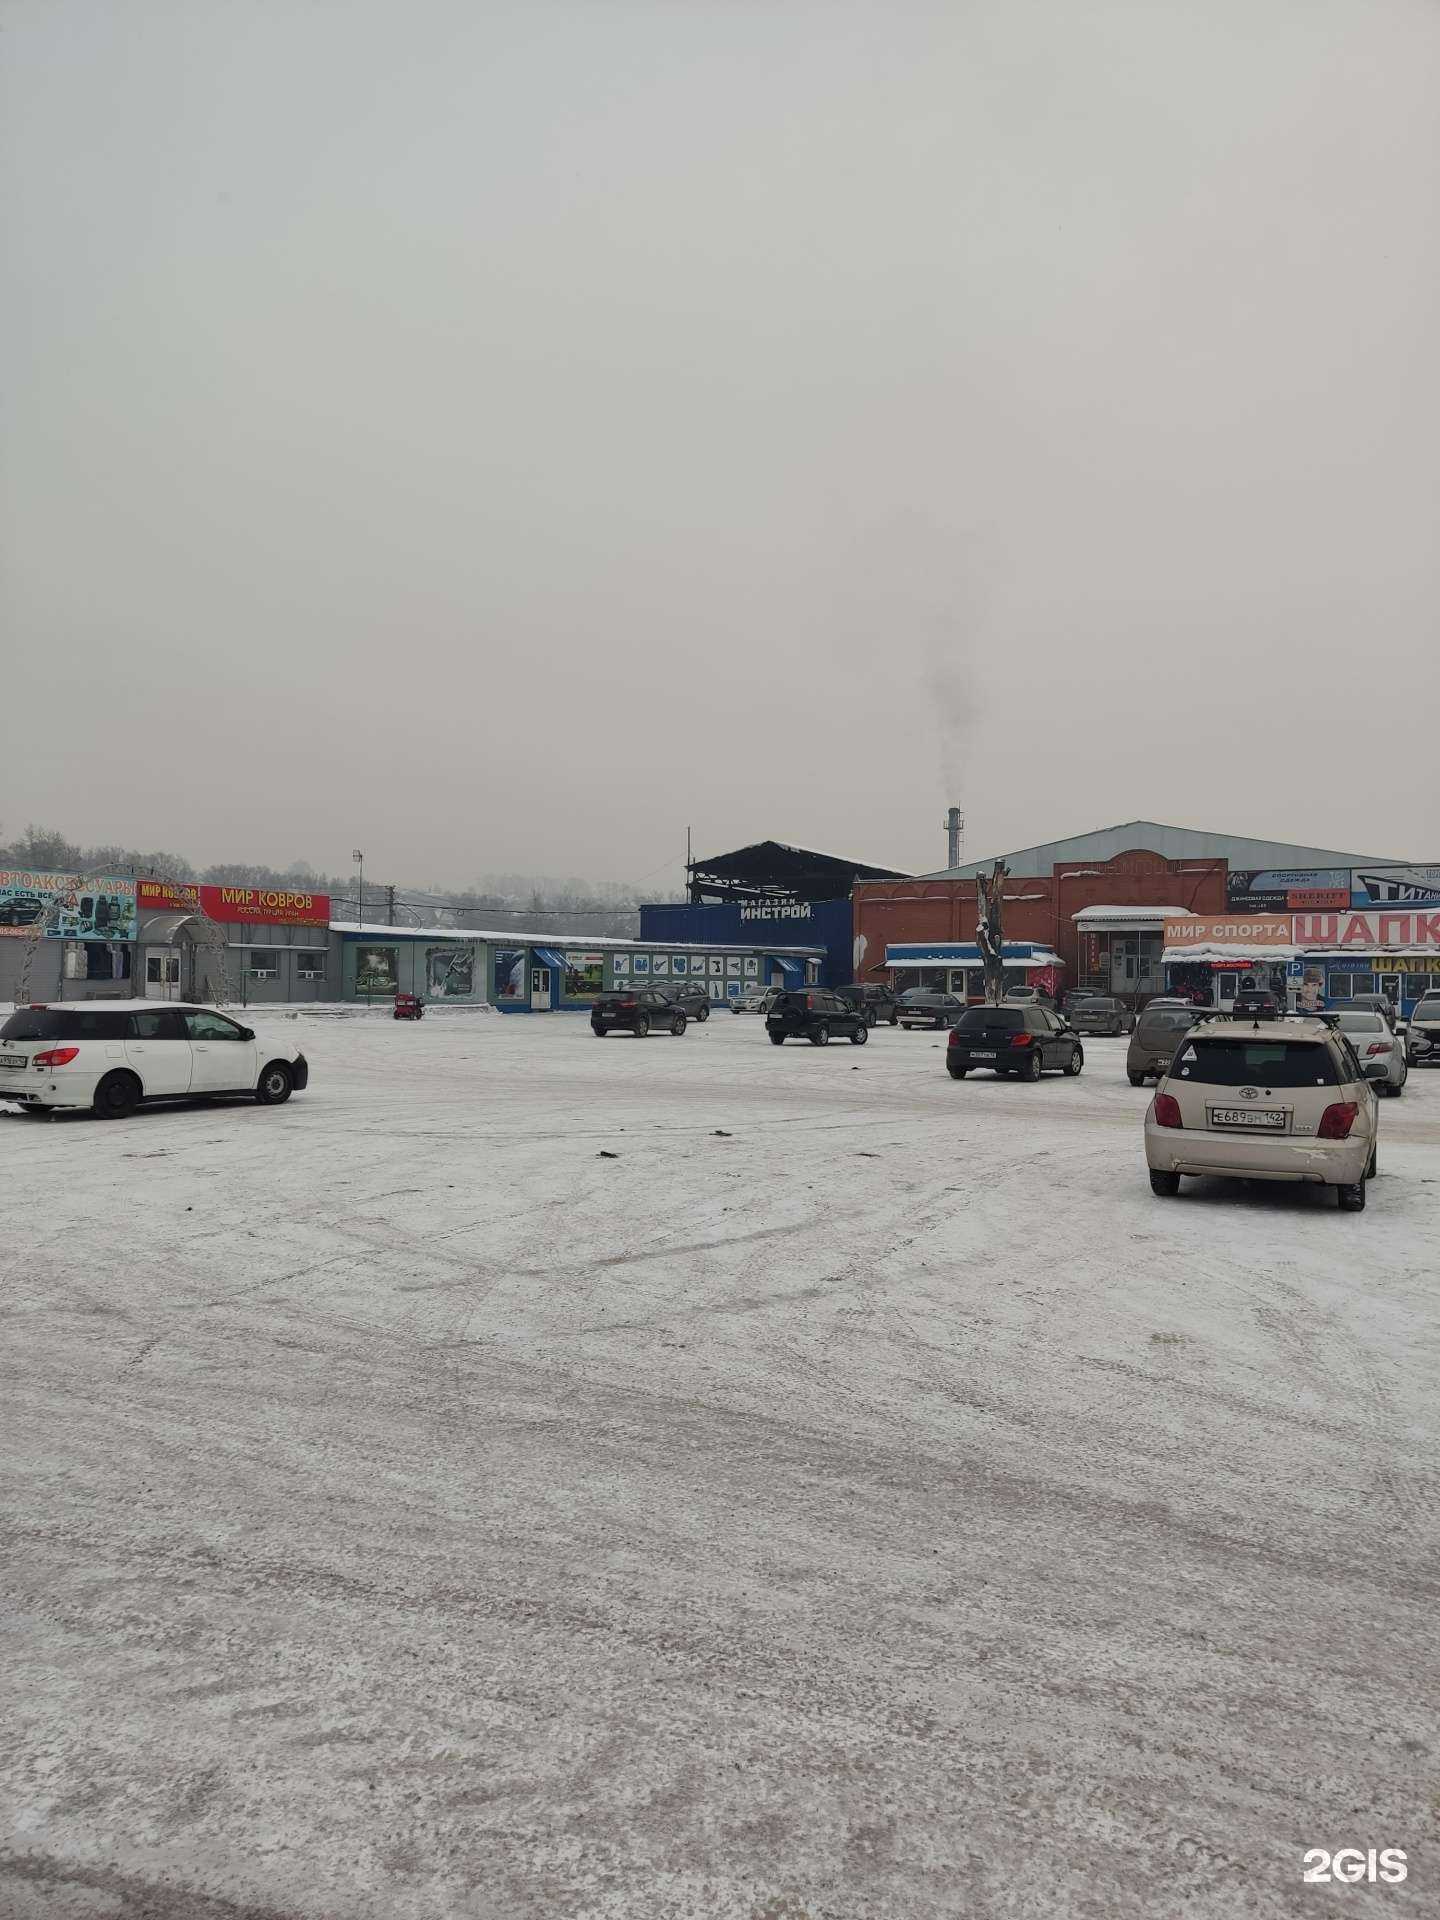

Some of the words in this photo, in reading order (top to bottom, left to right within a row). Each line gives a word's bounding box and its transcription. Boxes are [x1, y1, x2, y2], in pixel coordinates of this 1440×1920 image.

[15, 890, 36, 898] ЕСТЬ
[141, 883, 160, 897] МИР
[221, 888, 253, 904] МИР
[258, 892, 313, 909] КОВРОВ
[740, 902, 811, 919] ИНСТРОЙ
[1167, 924, 1205, 938] МИР
[1211, 923, 1289, 938] СПОРТА
